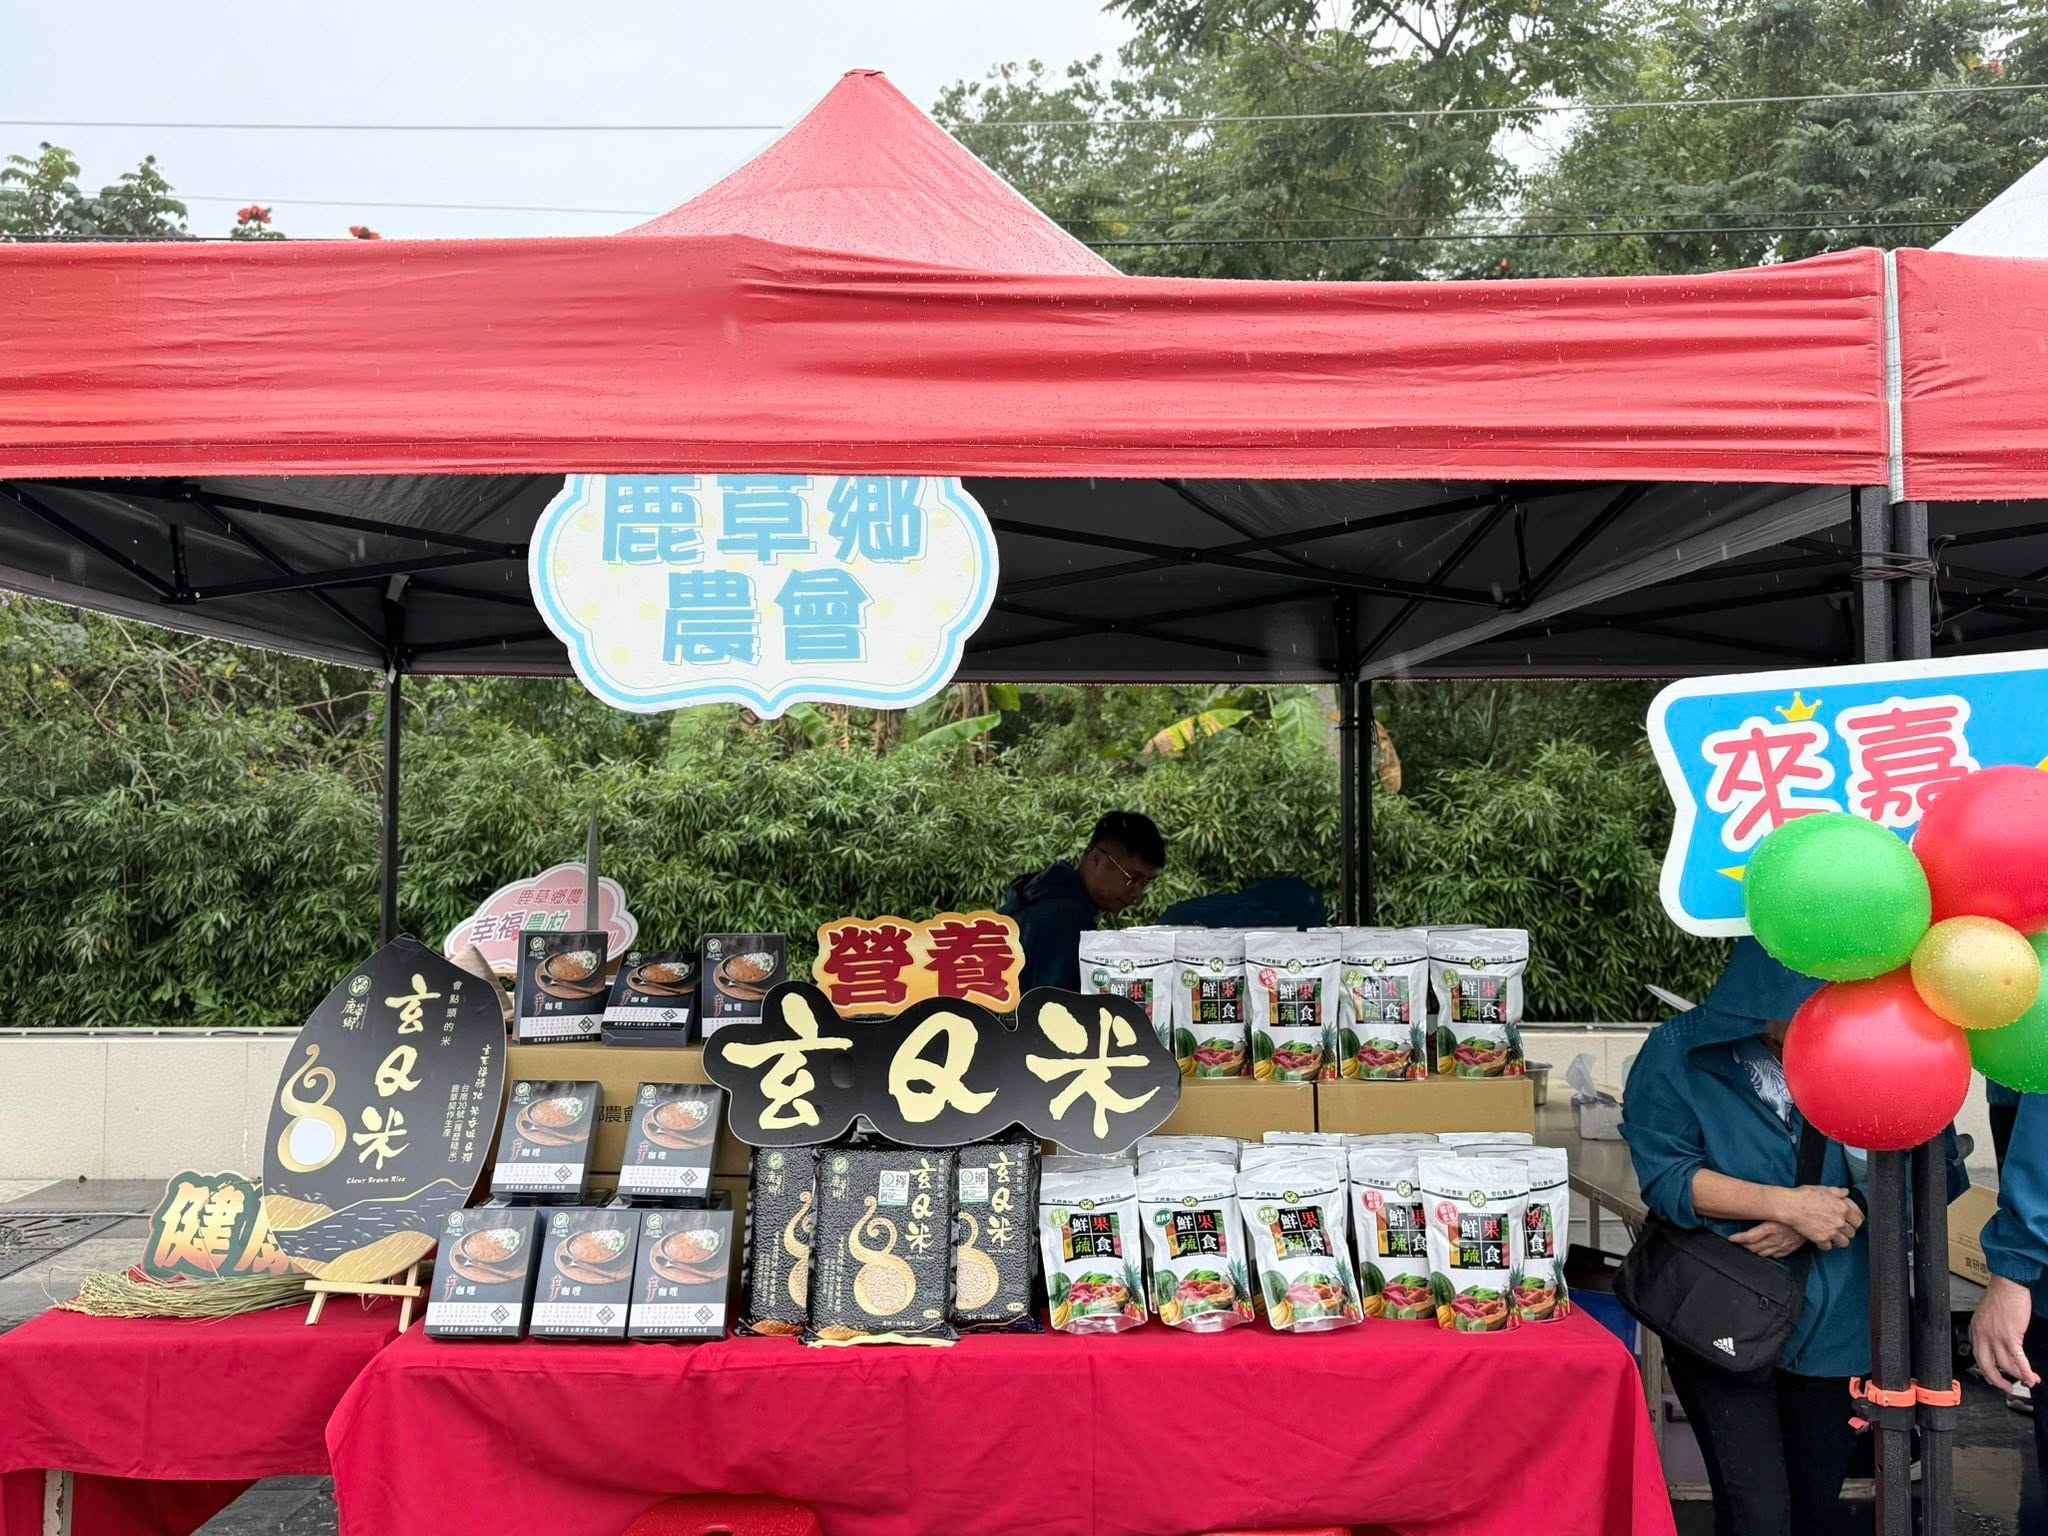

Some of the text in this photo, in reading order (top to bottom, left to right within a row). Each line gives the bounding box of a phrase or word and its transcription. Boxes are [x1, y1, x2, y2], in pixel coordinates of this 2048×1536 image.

[602, 474, 926, 564] 鹿草鄉
[662, 567, 873, 664] 農會
[824, 920, 1015, 1006] 營養
[1280, 982, 1314, 1000] 鮮果
[440, 980, 463, 1047] 會點頭的米
[353, 973, 442, 1169] 玄Q米
[722, 992, 1161, 1139] 玄Q米
[905, 1157, 938, 1254] 玄Q米
[987, 1151, 1016, 1248] 玄Q米
[1072, 1216, 1110, 1232] 鮮果
[1176, 1214, 1215, 1231] 鮮果
[1280, 1211, 1319, 1229] 鮮果
[1461, 1219, 1500, 1240] 鮮果
[1075, 1236, 1112, 1254] 蔬食
[1180, 1234, 1218, 1251] 蔬食
[1391, 1233, 1427, 1252] 蔬食
[1529, 1235, 1545, 1253] 食
[1463, 1245, 1501, 1264] 蔬食
